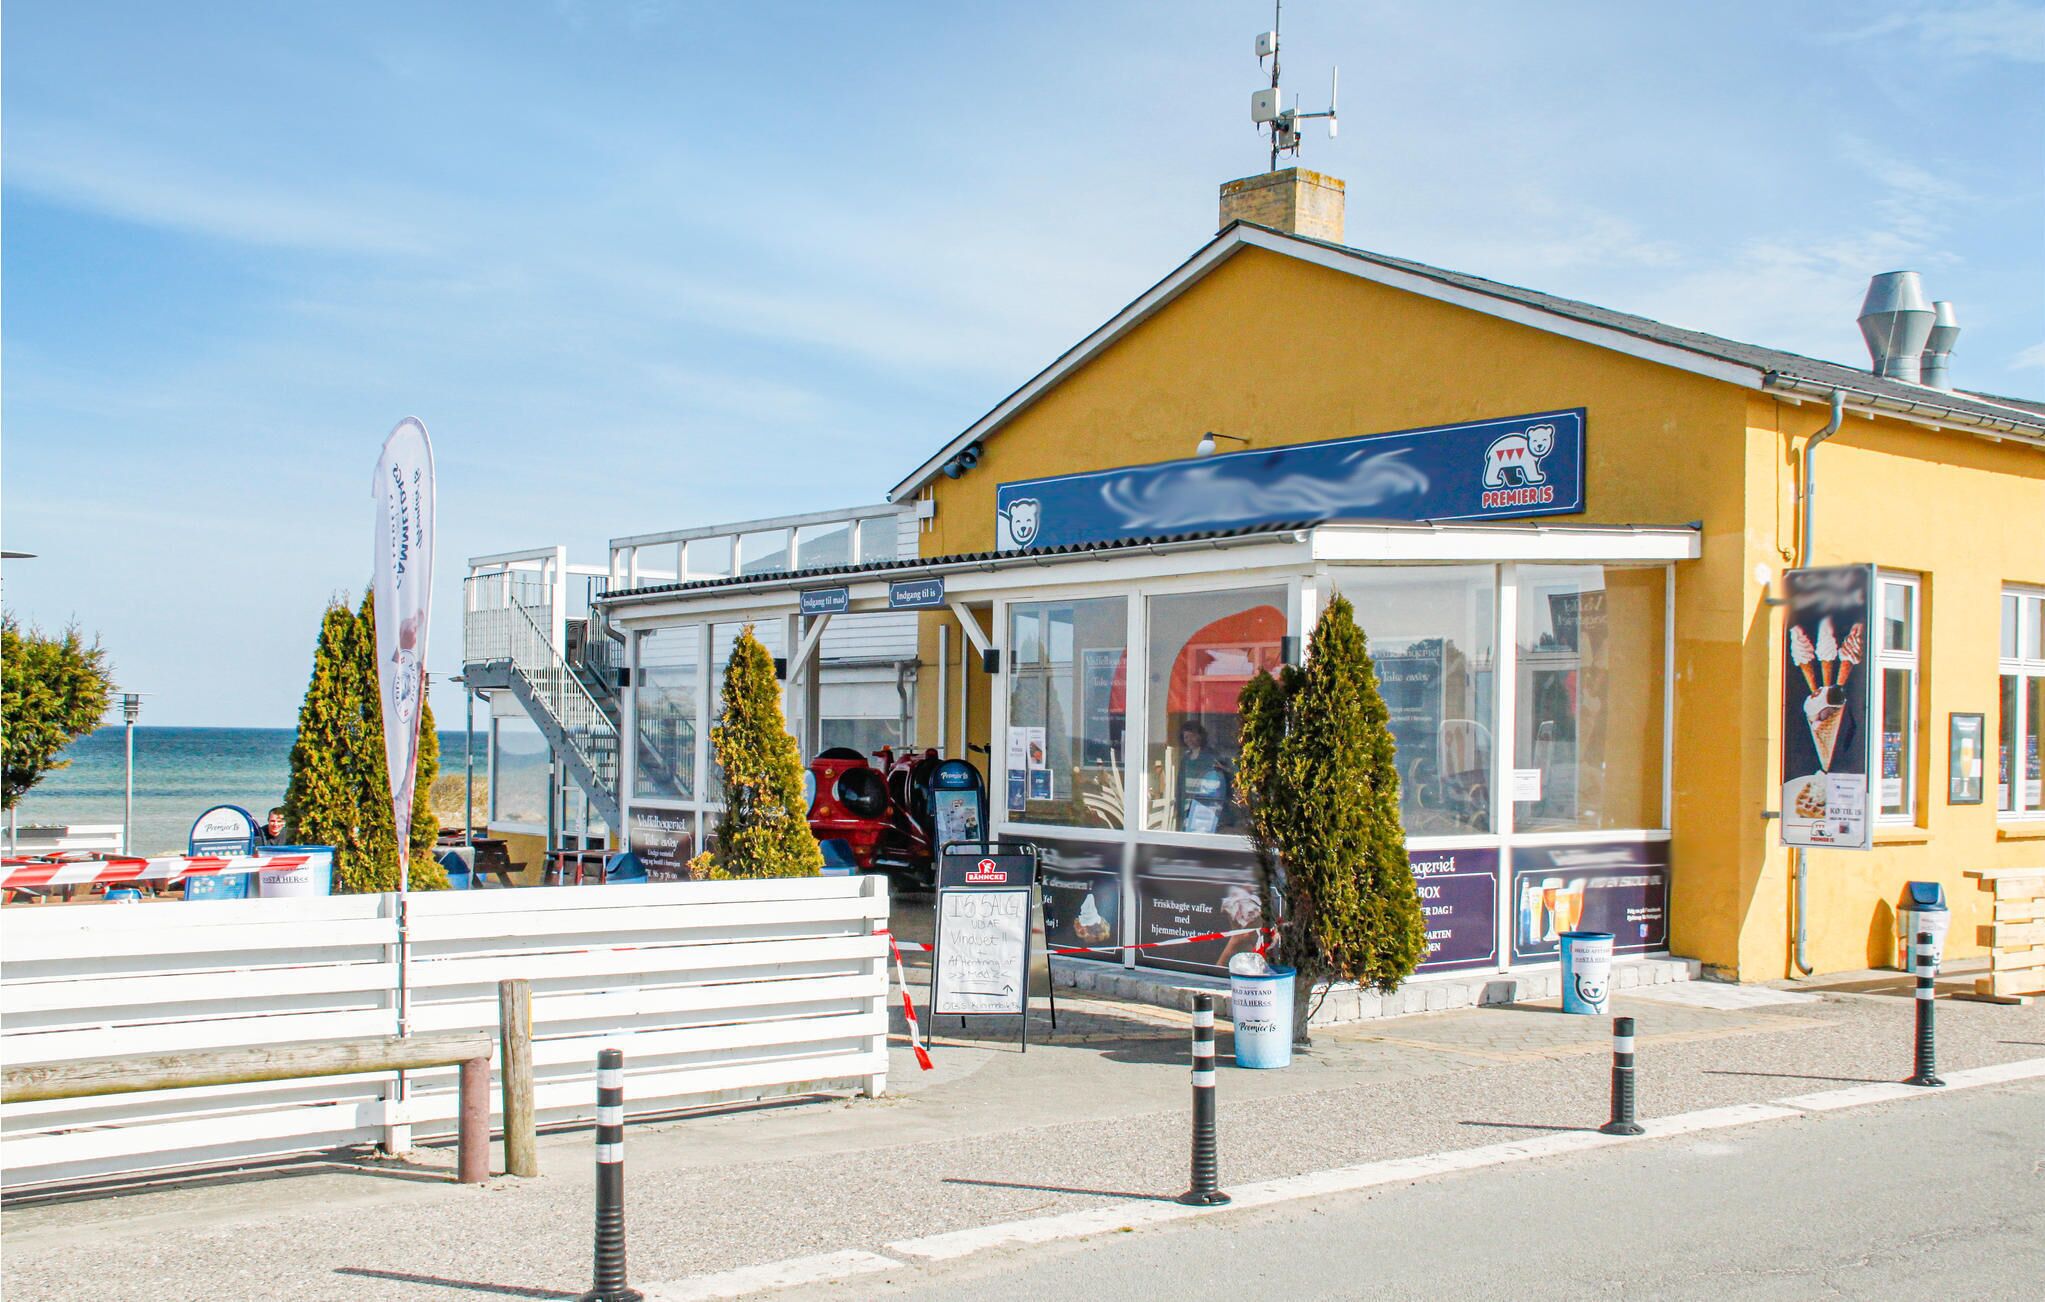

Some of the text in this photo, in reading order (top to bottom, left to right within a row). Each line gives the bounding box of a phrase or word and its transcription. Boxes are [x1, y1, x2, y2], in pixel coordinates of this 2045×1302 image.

[1482, 486, 1553, 509] PREMIER IS
[896, 591, 921, 601] Indgang
[930, 588, 936, 596] is
[804, 598, 825, 607] Indgang
[833, 596, 845, 604] mad
[1410, 856, 1456, 879] ageriet
[1153, 898, 1190, 912] Friskbagte
[1175, 915, 1190, 924] med
[1152, 924, 1196, 937] hjemmelavet
[1239, 1022, 1276, 1032] Premier Is
